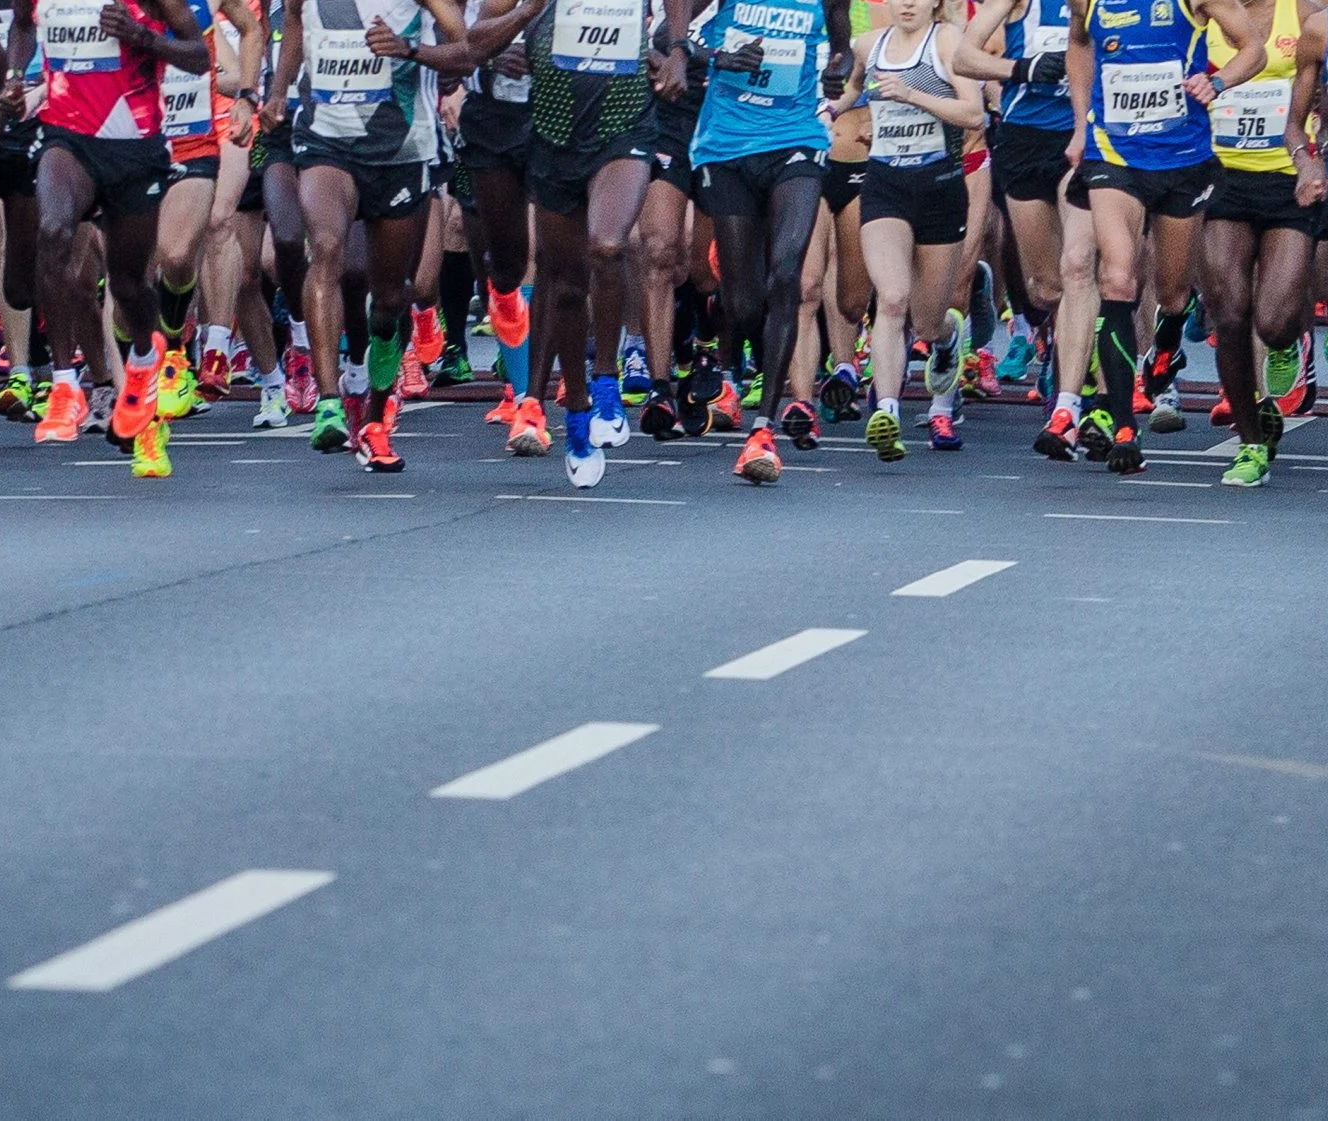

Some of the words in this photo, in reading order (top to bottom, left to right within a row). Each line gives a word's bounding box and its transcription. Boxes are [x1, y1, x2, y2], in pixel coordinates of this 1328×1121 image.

[577, 25, 622, 46] TOLA
[316, 57, 385, 76] BIRHANU
[1112, 89, 1170, 110] TOBIAS
[1237, 116, 1266, 137] 576
